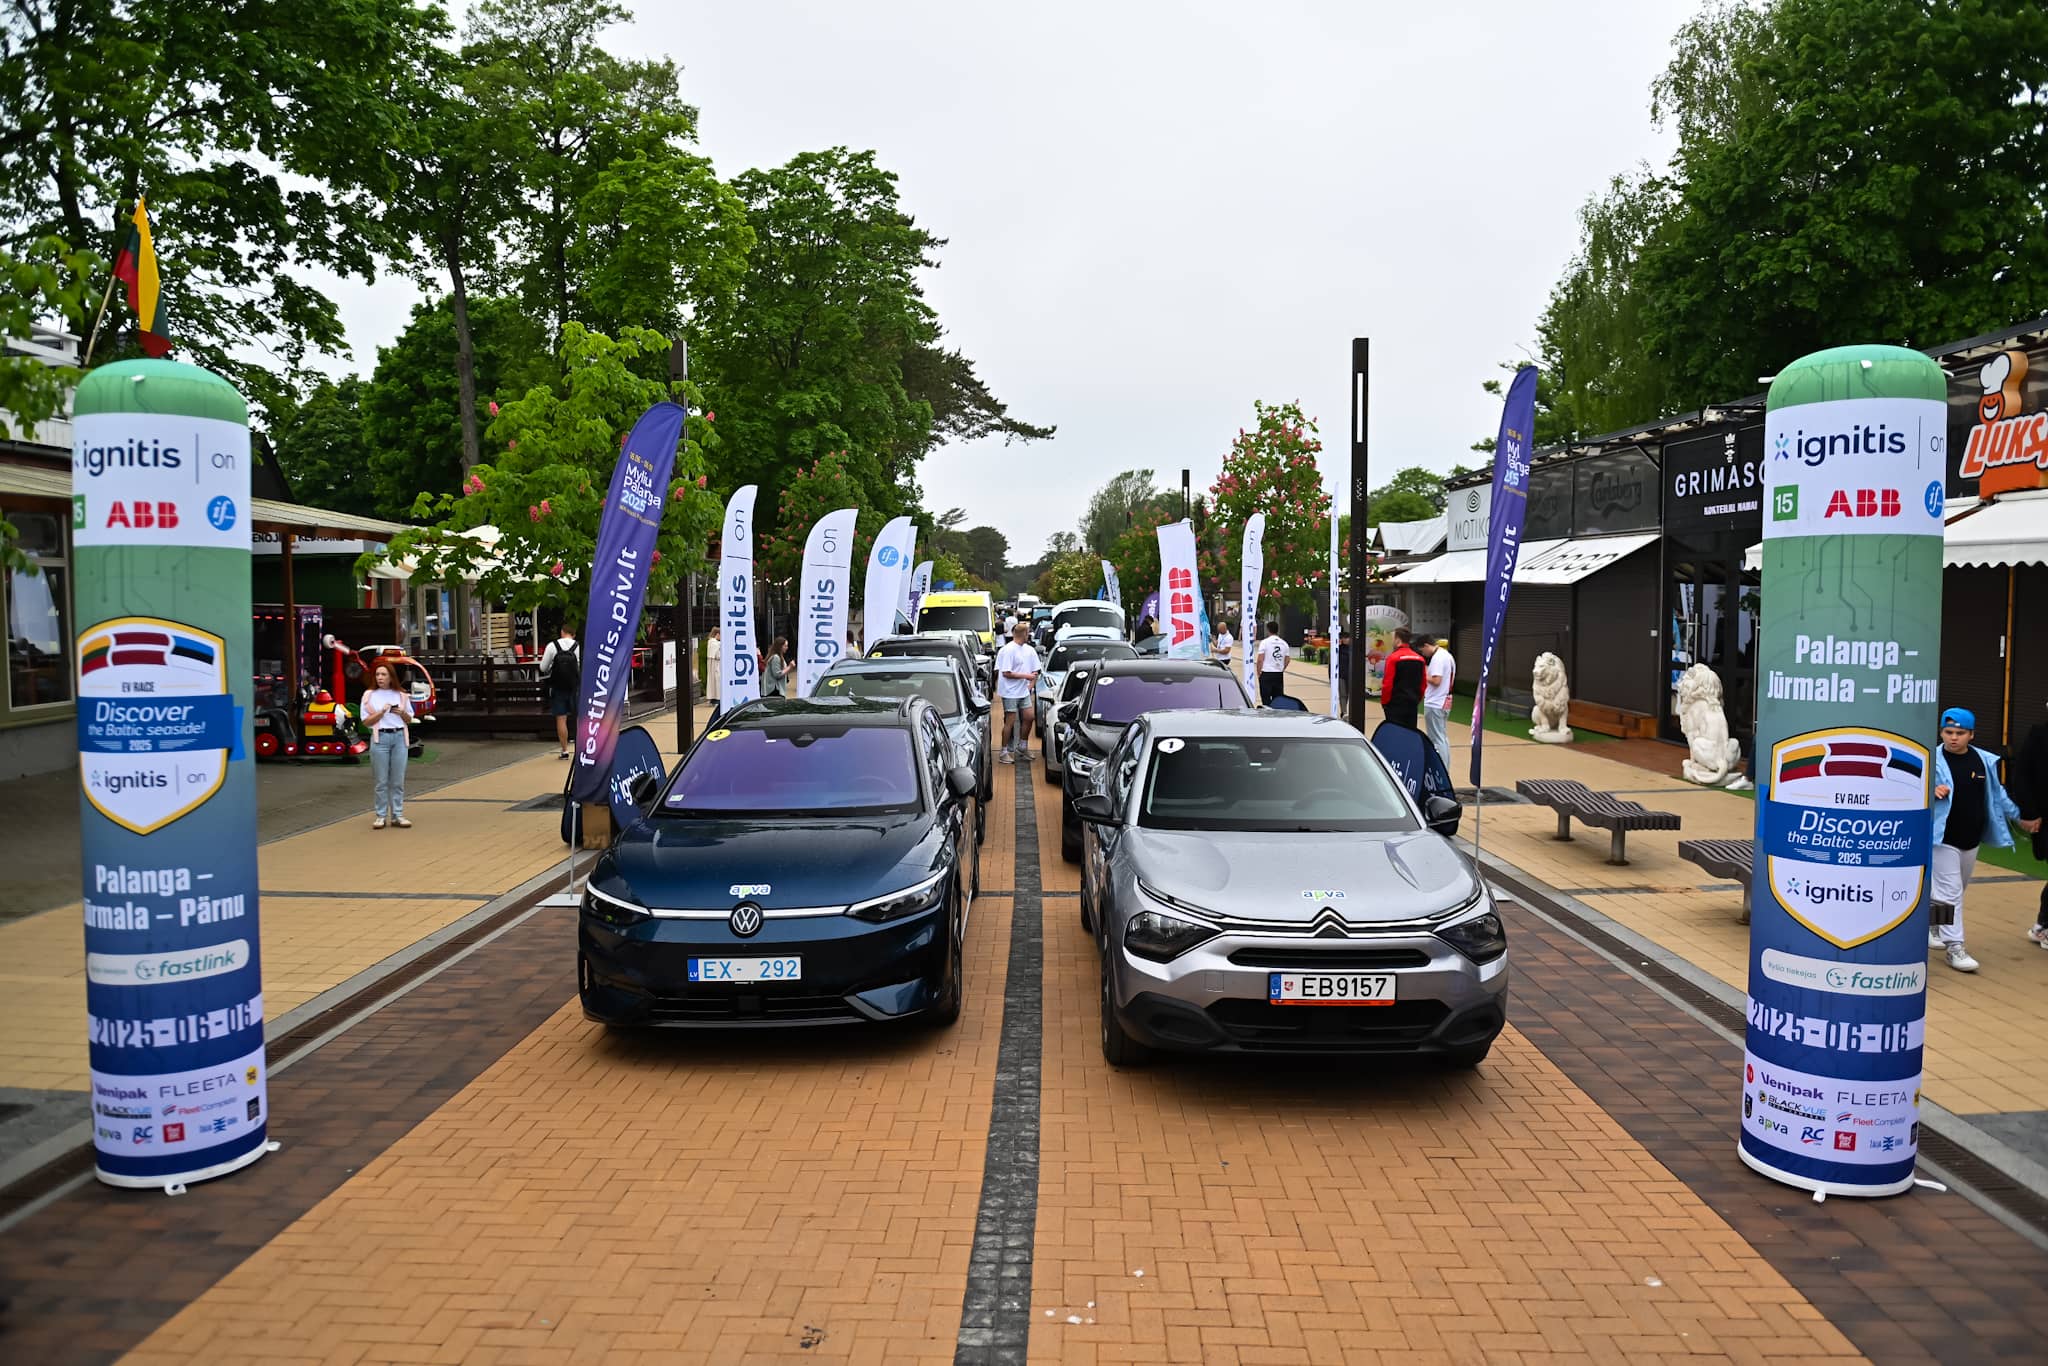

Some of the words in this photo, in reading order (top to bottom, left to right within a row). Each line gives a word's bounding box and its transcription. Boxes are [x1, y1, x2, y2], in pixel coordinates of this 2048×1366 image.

[1797, 424, 1906, 466] ignitis
[1930, 436, 1944, 453] on
[84, 438, 181, 477] ignitis
[211, 453, 236, 470] on
[621, 490, 647, 513] 2025
[1776, 493, 1793, 514] 15
[1824, 489, 1902, 518] ABB
[106, 501, 180, 528] ABB
[735, 509, 745, 541] on
[823, 528, 837, 553] on
[728, 574, 755, 686] ignitis
[808, 578, 840, 664] ignitis
[579, 546, 638, 768] festivalis.piv.lt
[1795, 635, 1900, 670] Palanga
[121, 682, 132, 692] EV
[1767, 670, 1855, 703] Jūrmala
[1887, 674, 1937, 704] Pärnu
[96, 701, 194, 722] Discover
[87, 724, 104, 736] the
[105, 723, 144, 736] Baltic
[146, 721, 206, 736] seaside!
[104, 771, 168, 793] ignitis
[187, 773, 207, 784] on
[1835, 792, 1845, 804] EV
[1848, 793, 1870, 805] RACE
[1800, 810, 1904, 836] Discover
[1787, 831, 1808, 845] the
[1811, 833, 1855, 849] Baltic
[1857, 837, 1912, 850] seaside!
[1838, 852, 1862, 864] 2025
[95, 865, 191, 896] Palanga
[731, 885, 770, 897] apva
[1805, 880, 1874, 904] ignitis
[1891, 890, 1908, 901] on
[1304, 890, 1345, 900] apva
[180, 894, 245, 927] Pärnu
[159, 950, 236, 977] fastlink
[760, 960, 798, 978] 292
[1302, 977, 1388, 998] EB9157
[1851, 972, 1919, 989] fastlink
[96, 1003, 252, 1049] 2025-06-06
[1752, 1002, 1909, 1052] 2025-06-06
[159, 1073, 238, 1098] FLEETA
[1761, 1071, 1825, 1101] Venipak
[1837, 1091, 1908, 1107] FLEETA
[133, 1126, 153, 1140] RC
[1758, 1115, 1789, 1135] apva
[1801, 1126, 1825, 1141] RC
